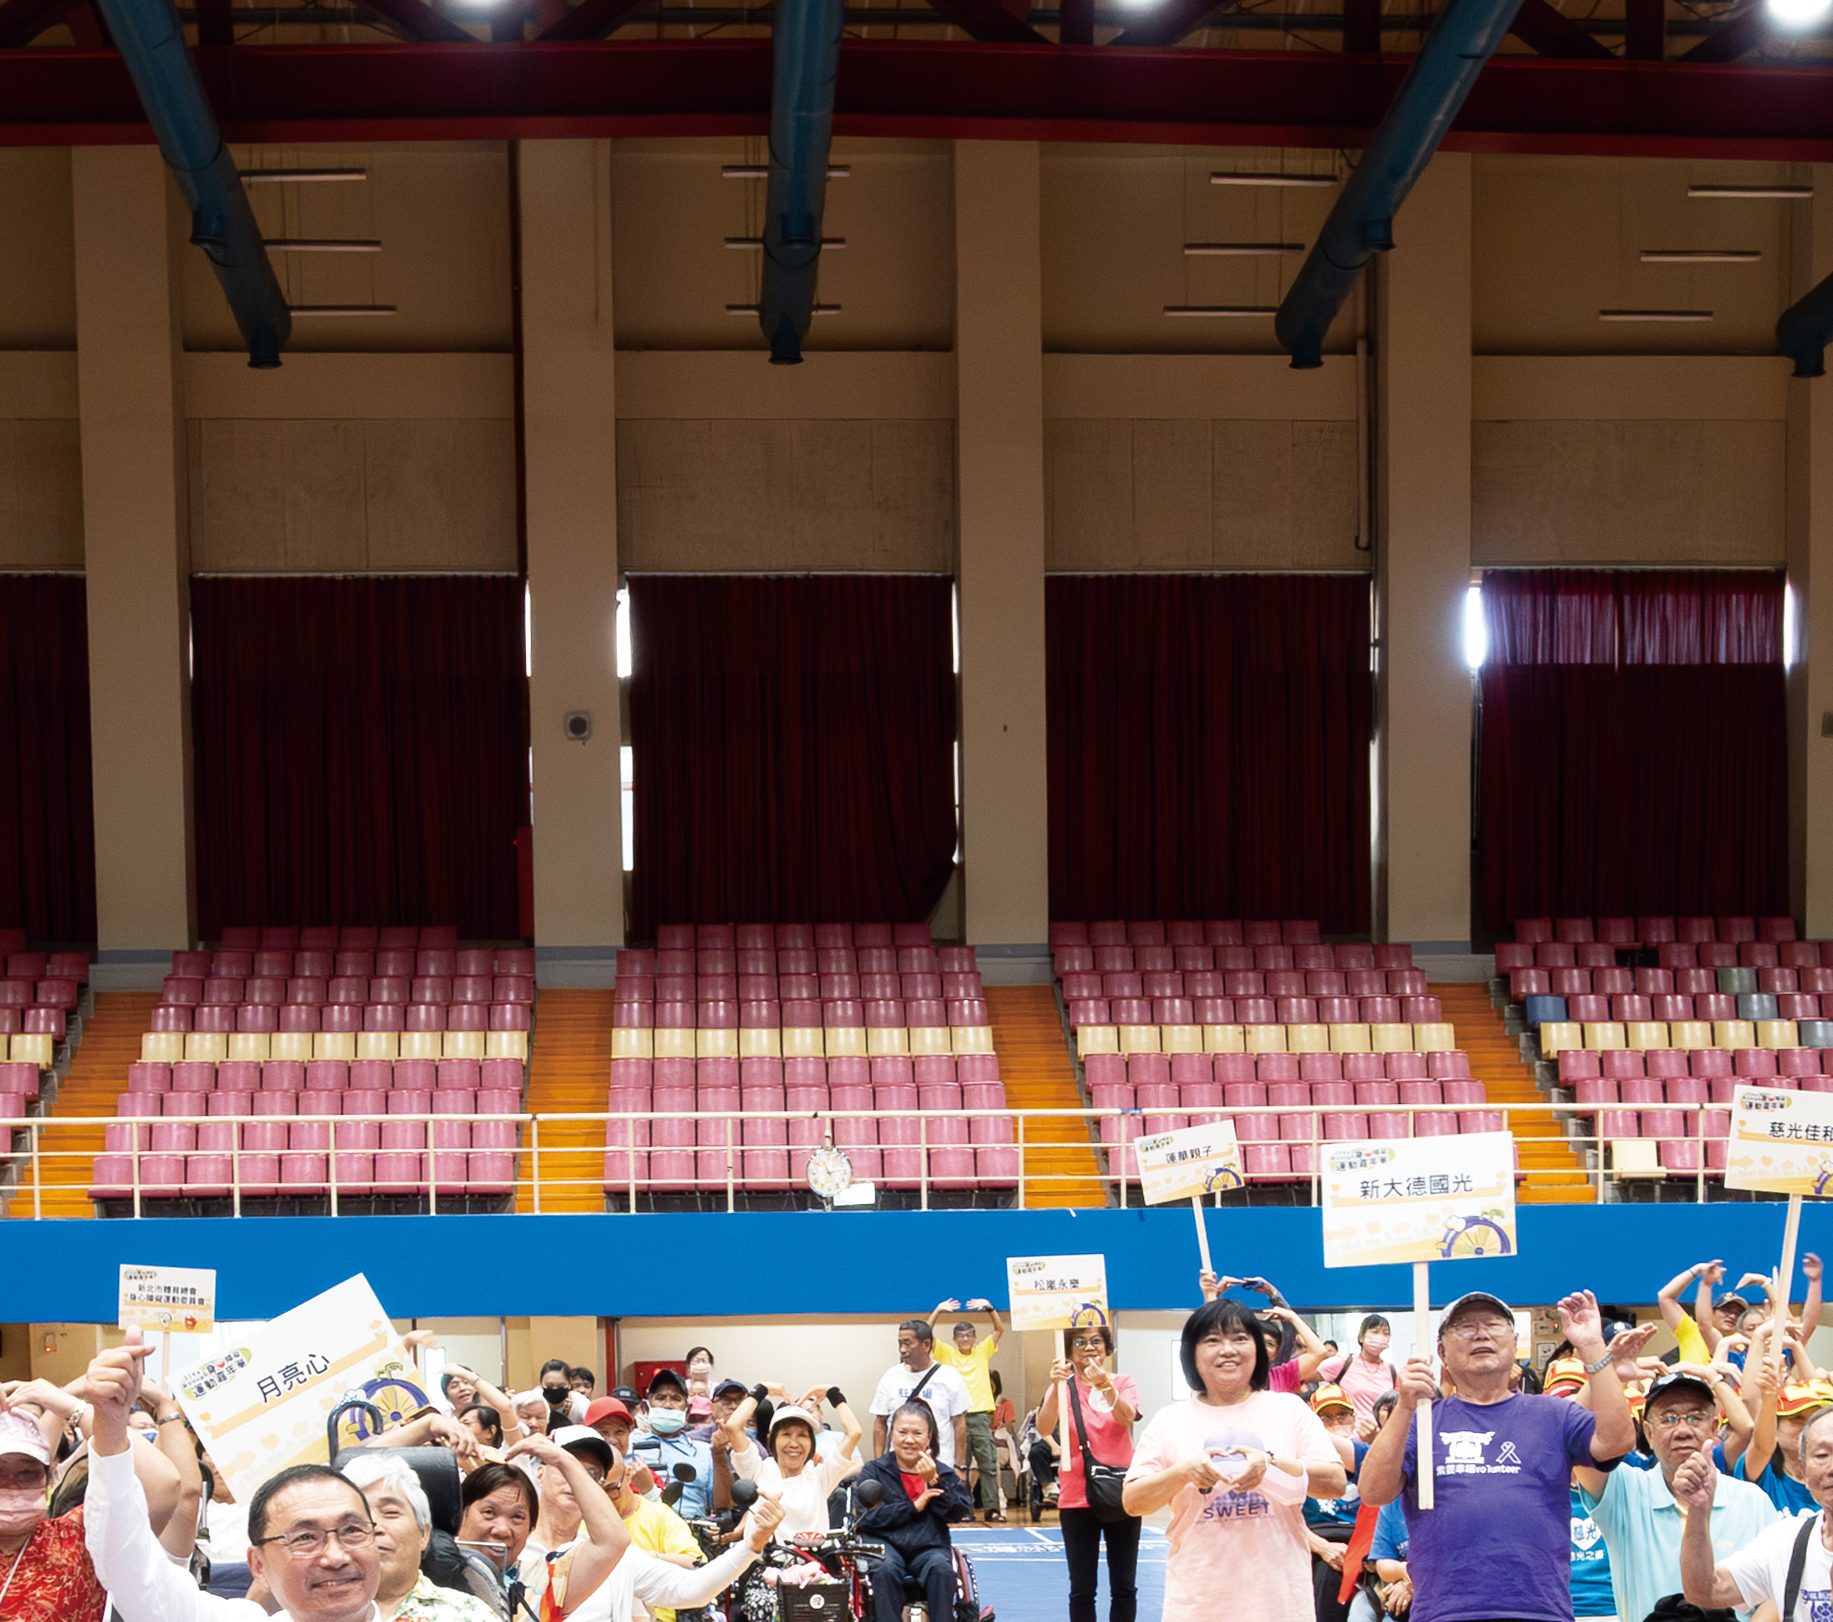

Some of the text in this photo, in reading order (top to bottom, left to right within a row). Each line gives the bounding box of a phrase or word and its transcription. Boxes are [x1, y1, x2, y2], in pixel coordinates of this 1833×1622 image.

[1360, 1173, 1473, 1199] 新大德國光
[256, 1353, 330, 1403] 月亮心
[1203, 1502, 1270, 1520] SWEET
